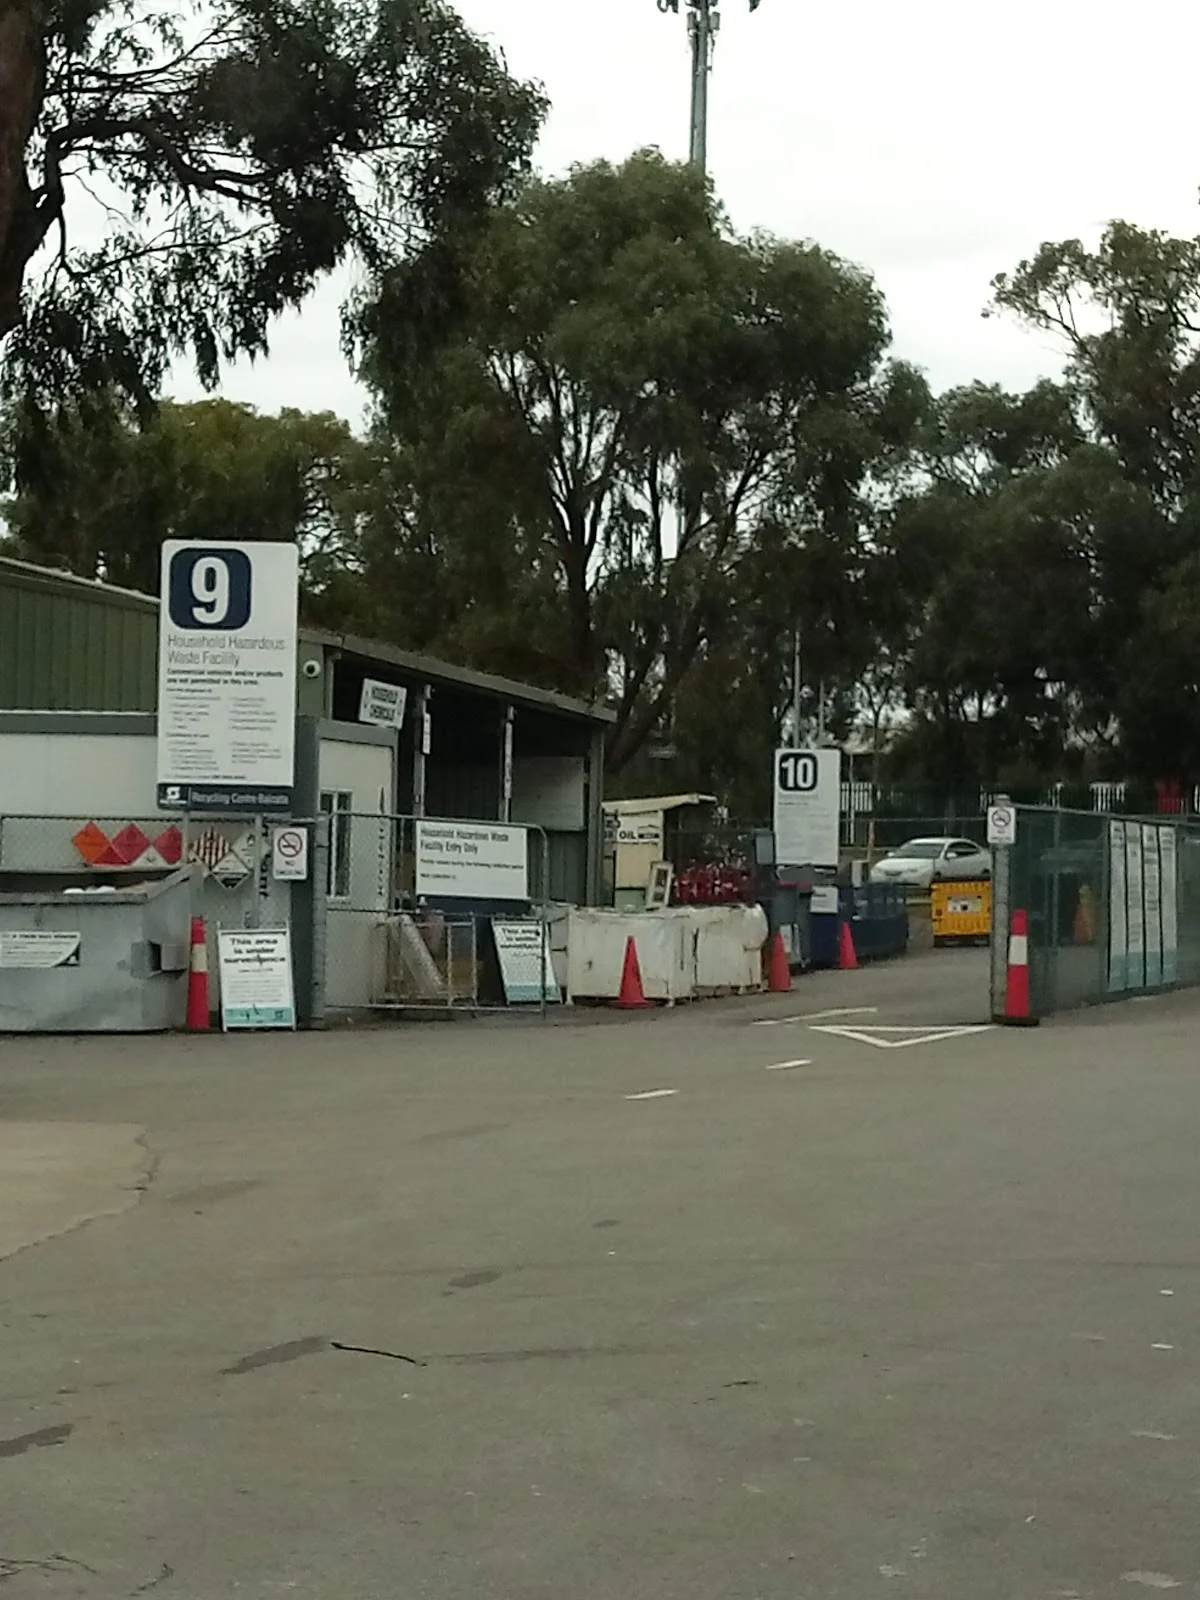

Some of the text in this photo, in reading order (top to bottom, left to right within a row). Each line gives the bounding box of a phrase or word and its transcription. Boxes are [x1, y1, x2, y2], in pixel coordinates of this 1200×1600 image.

[191, 556, 229, 624] 9
[167, 635, 285, 650] Household Hazardous
[168, 651, 239, 667] Waste Facility
[781, 757, 814, 789] 10
[191, 791, 230, 805] Recycling
[231, 792, 257, 804] Centre
[420, 829, 509, 842] Household Hazardous Waste
[619, 831, 637, 840] OIL
[420, 840, 478, 855] Facility Entry Only
[223, 956, 286, 964] surveillance
